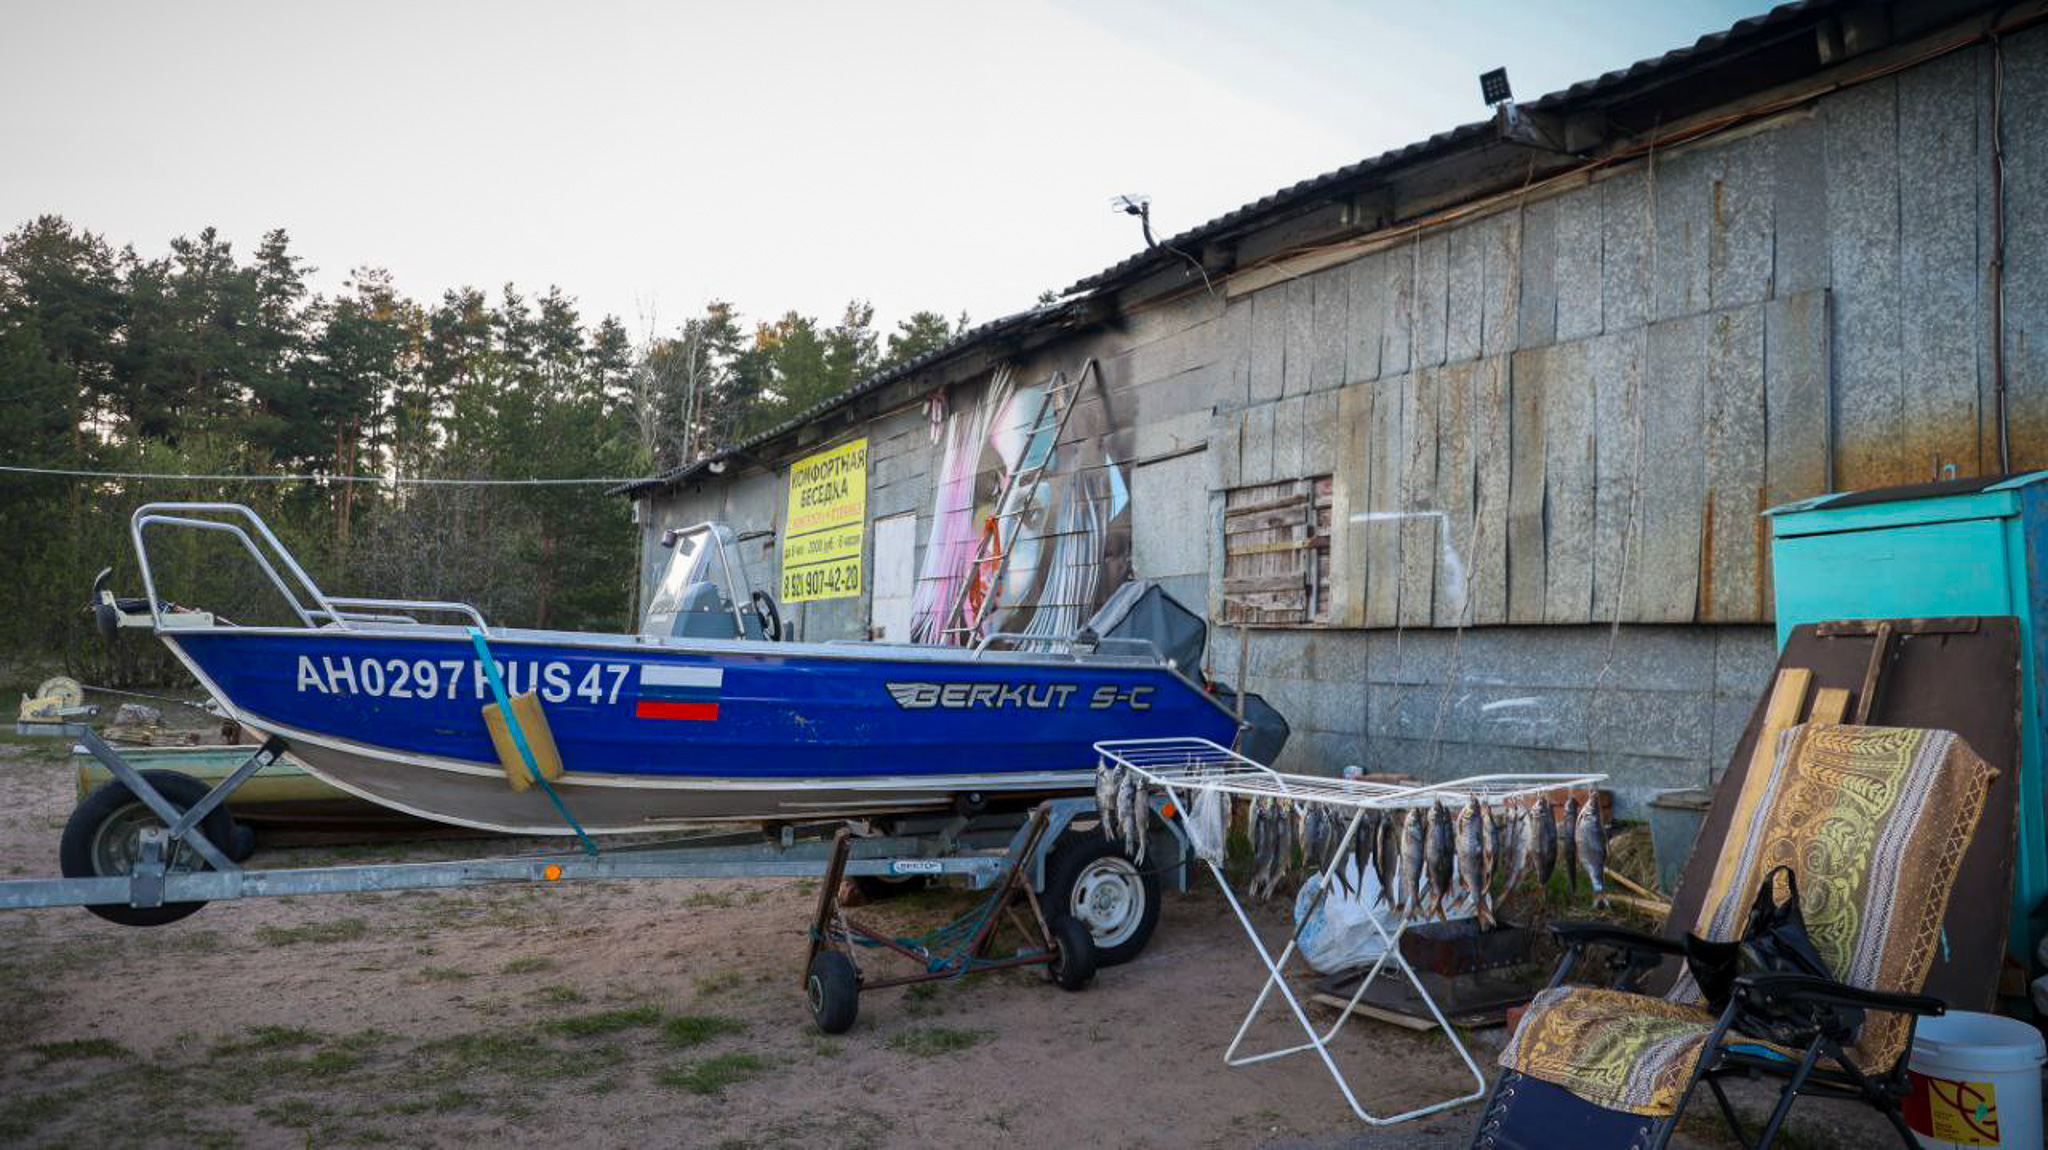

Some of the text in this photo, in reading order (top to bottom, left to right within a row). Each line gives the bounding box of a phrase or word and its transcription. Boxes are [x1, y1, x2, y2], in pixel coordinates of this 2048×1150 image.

[792, 449, 865, 488] КОМФОРТНАЯ
[801, 478, 848, 507] БЕСЕДКА
[784, 576, 790, 598] 8
[806, 565, 858, 595] 907-42-20
[886, 683, 1154, 709] BERKUT S-C
